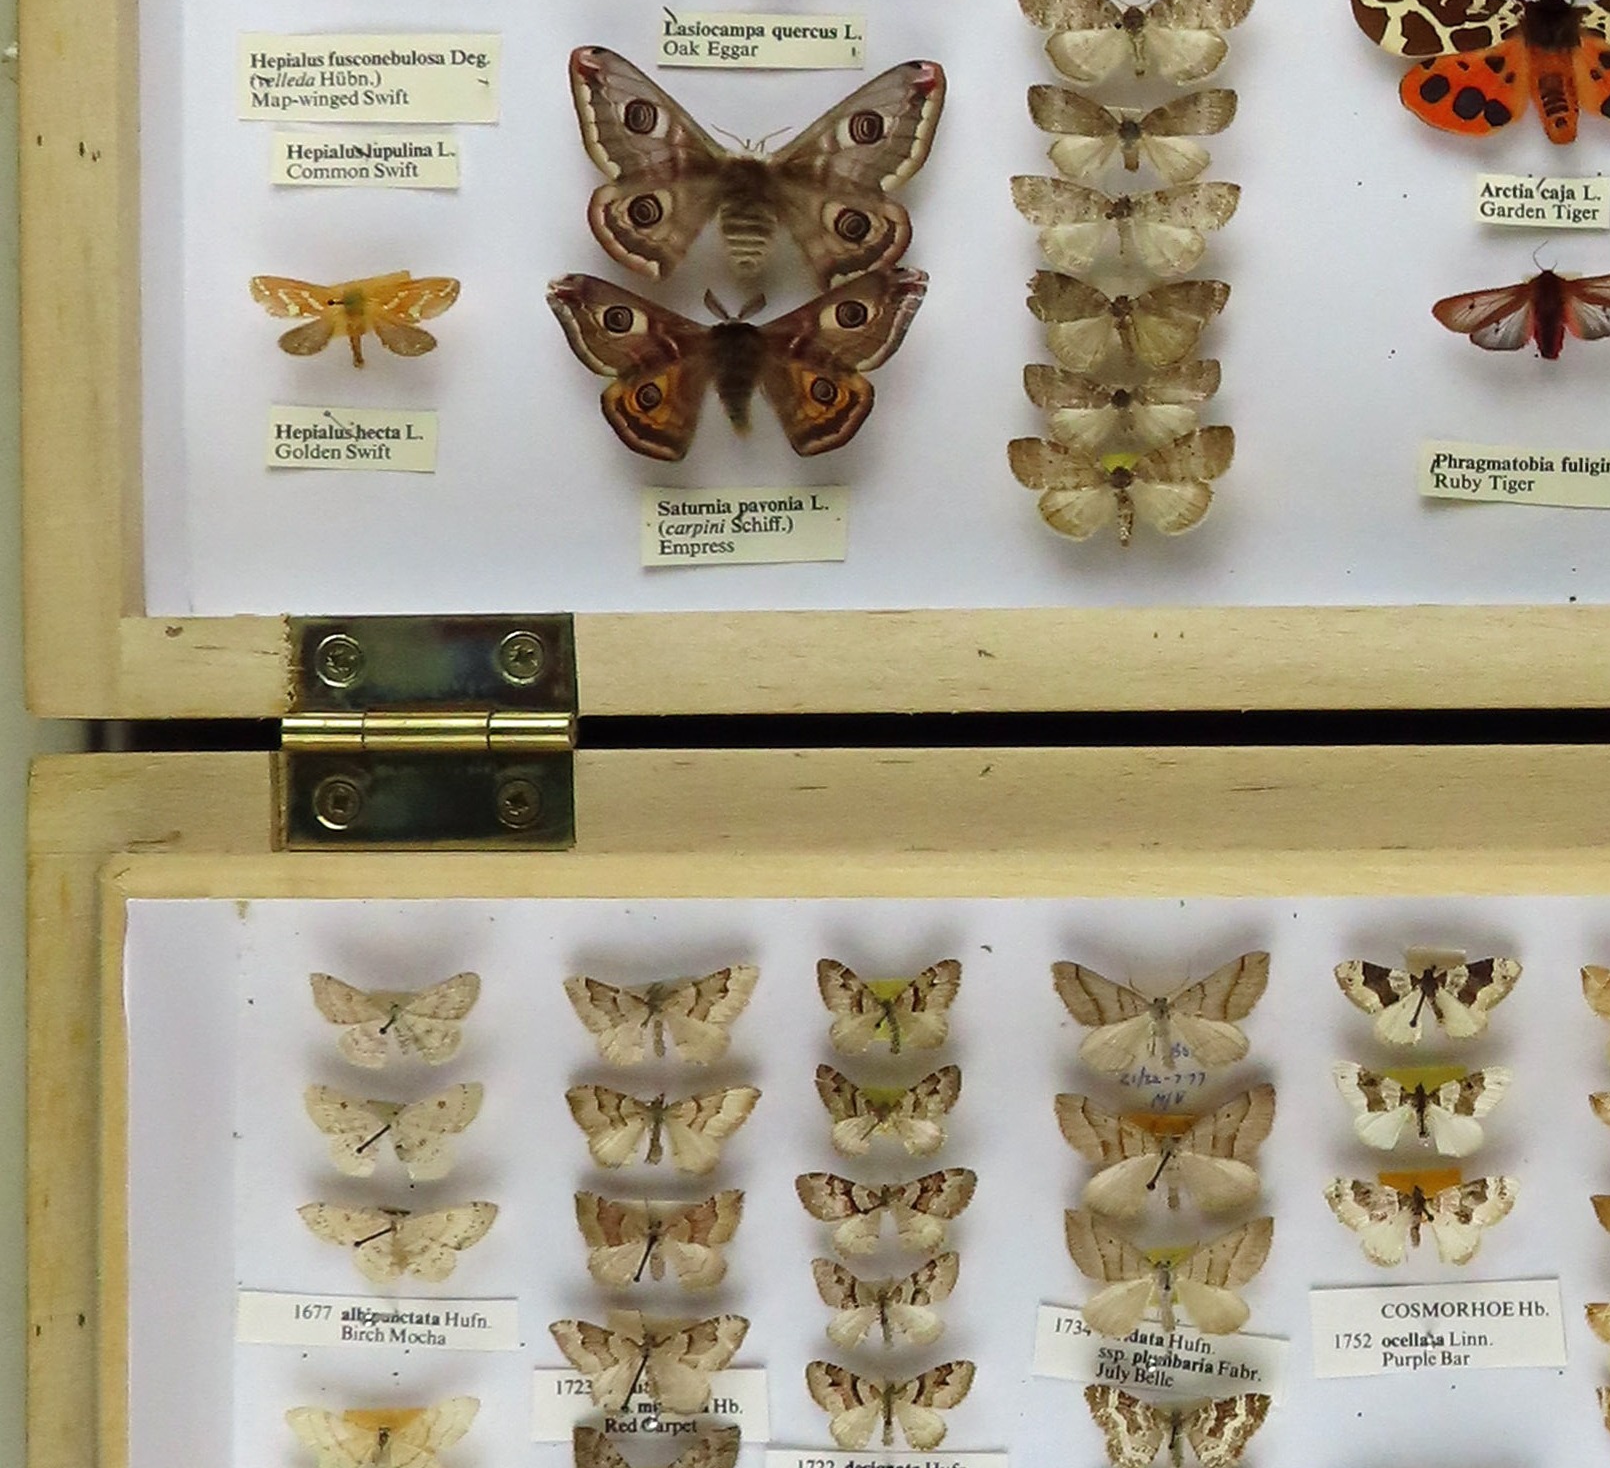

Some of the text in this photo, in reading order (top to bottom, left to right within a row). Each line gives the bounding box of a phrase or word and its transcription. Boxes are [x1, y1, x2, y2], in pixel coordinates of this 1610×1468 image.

[663, 20, 838, 41] Lasiocampa quercus
[663, 39, 758, 59] Oak Eggar
[250, 49, 490, 71] Hepialus fusconebulosa Deg.
[252, 89, 409, 110] Map-winged Swift
[287, 162, 419, 180] Common Swift
[1480, 182, 1601, 202] Arctia caja L.
[1480, 201, 1600, 222] Garden Tiger
[355, 423, 401, 439] hecta
[275, 443, 391, 460] Golden Swift
[1435, 453, 1555, 474] Phragmatobia
[1433, 473, 1536, 494] Ruby Tiger
[657, 494, 830, 517] Saturnia pavonia L.
[657, 519, 725, 538] (carpini
[658, 538, 736, 558] Empress
[1380, 1300, 1550, 1320] COSMORHOE Hb.
[341, 1325, 447, 1346] Birch Mocha
[1381, 1351, 1471, 1370] Purple Bar
[1096, 1362, 1129, 1381] July
